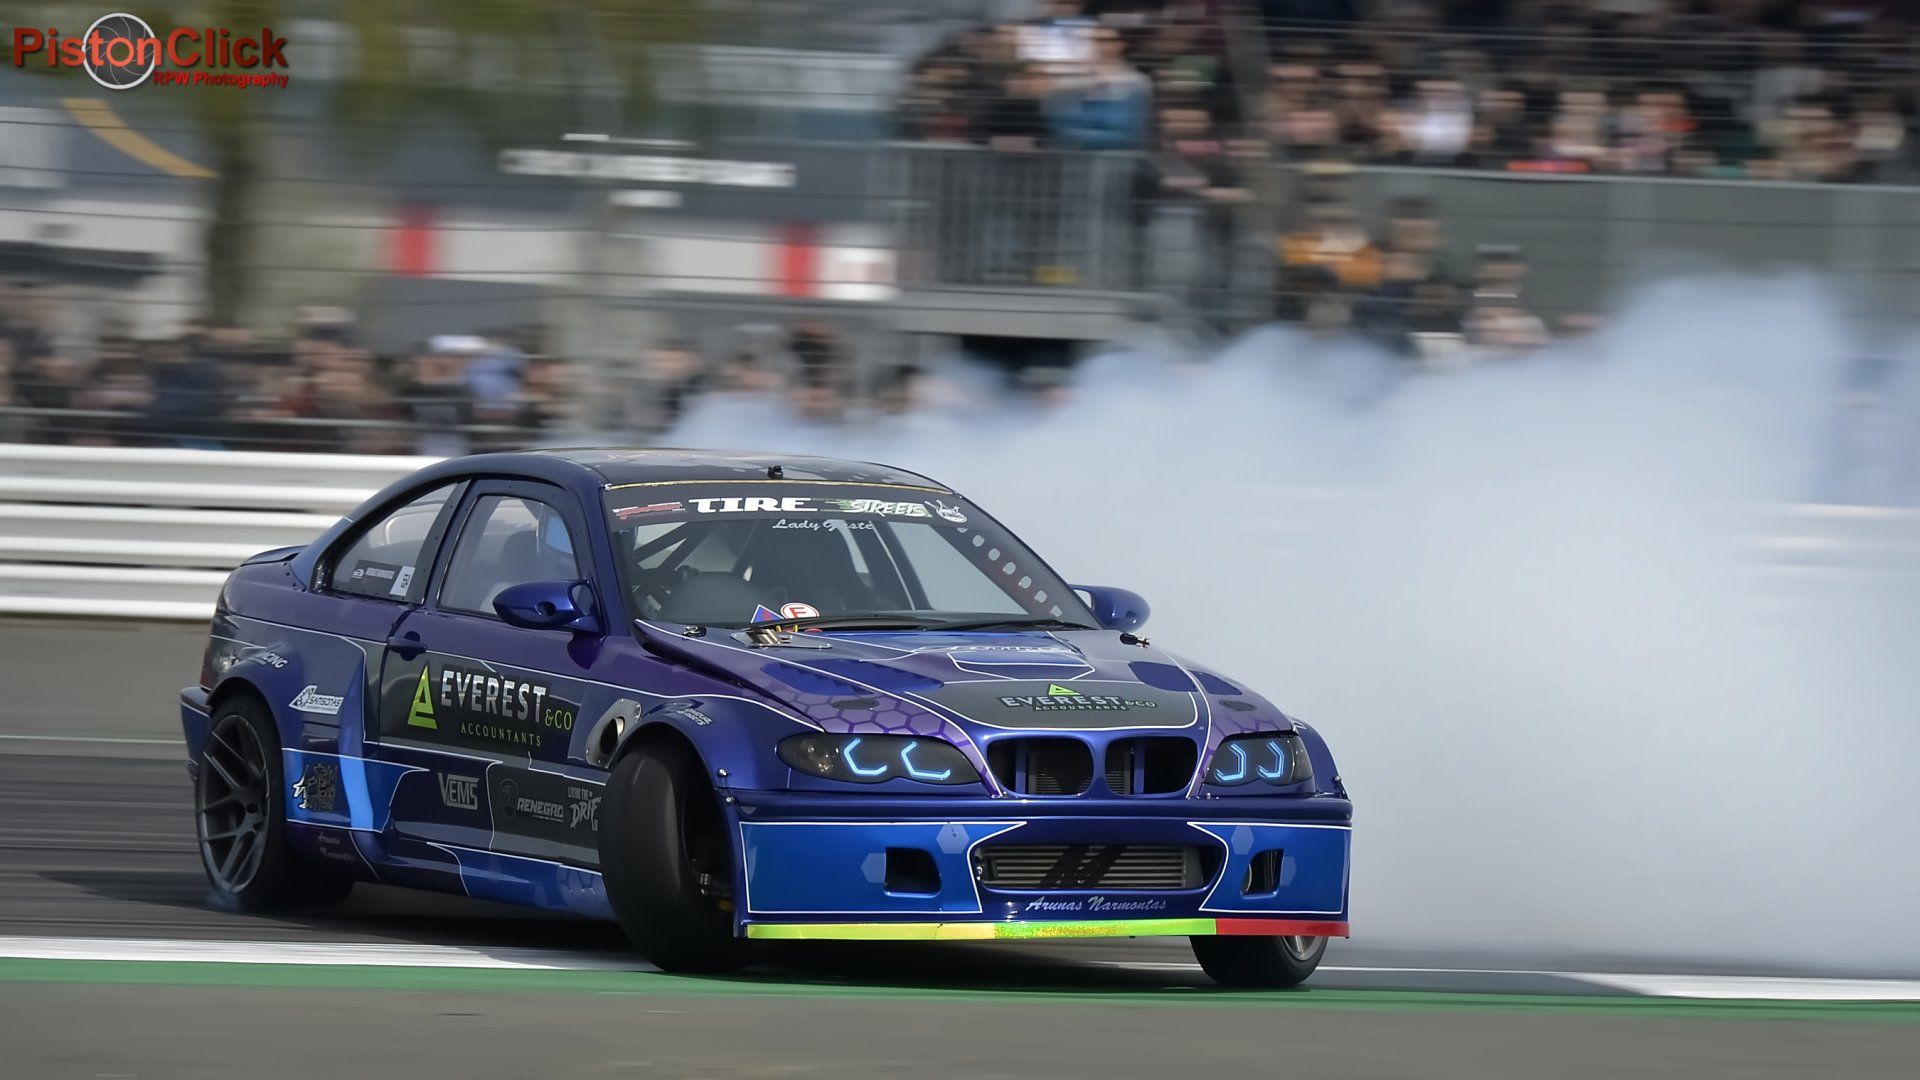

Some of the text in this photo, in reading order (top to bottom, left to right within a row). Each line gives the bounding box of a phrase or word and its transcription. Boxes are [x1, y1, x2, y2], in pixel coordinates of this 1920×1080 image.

[688, 497, 818, 513] TIRE
[842, 498, 932, 518] STREETS
[772, 518, 874, 532] Lady Gste
[440, 669, 572, 731] EVEREST &CO
[1000, 696, 1121, 707] EVEREST
[460, 722, 542, 747] ACCOUNTANTS
[438, 772, 480, 811] VEMS
[1025, 895, 1167, 912] Arunas Narmontas
